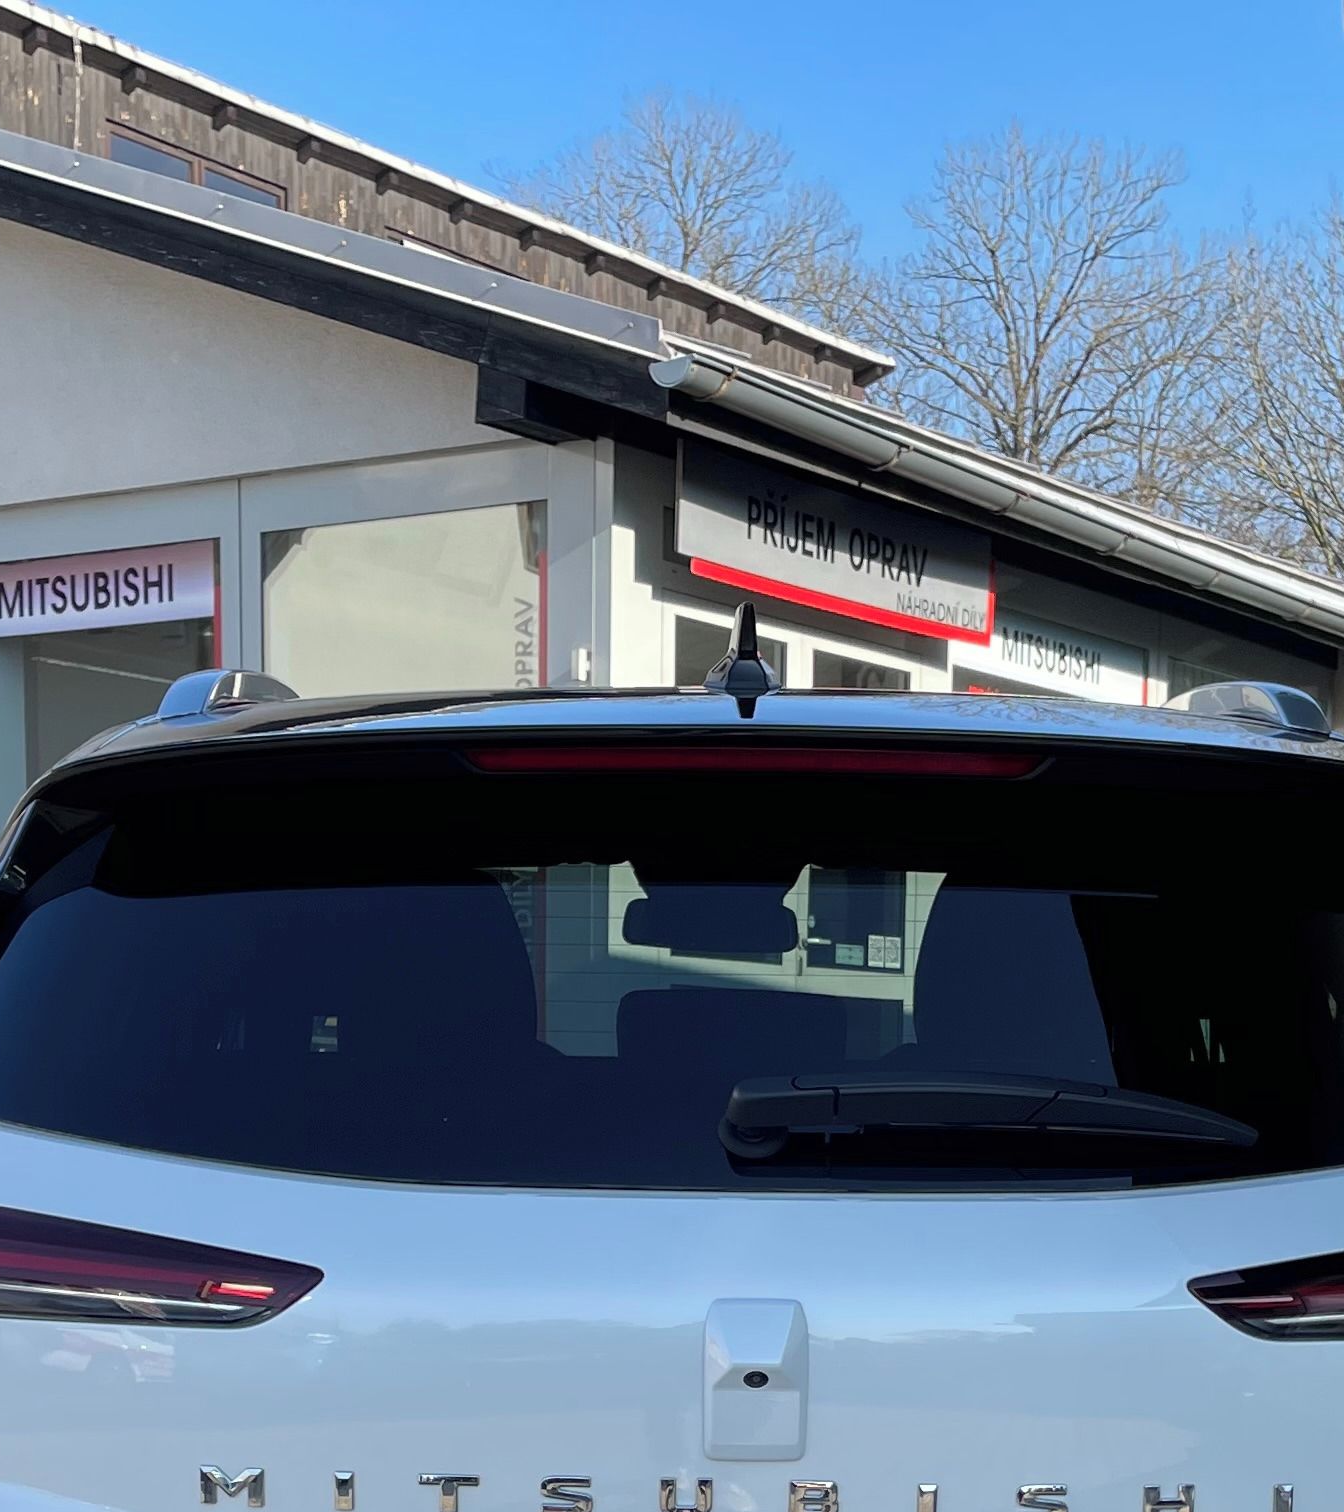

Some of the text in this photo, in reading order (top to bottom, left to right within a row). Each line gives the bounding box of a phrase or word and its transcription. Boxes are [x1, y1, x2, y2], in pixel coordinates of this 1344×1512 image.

[747, 488, 928, 588] PŘÍJEM OPRAV
[896, 591, 986, 631] NÁHRADNÍ DÍLY
[1001, 627, 1102, 686] MITSUBISHI
